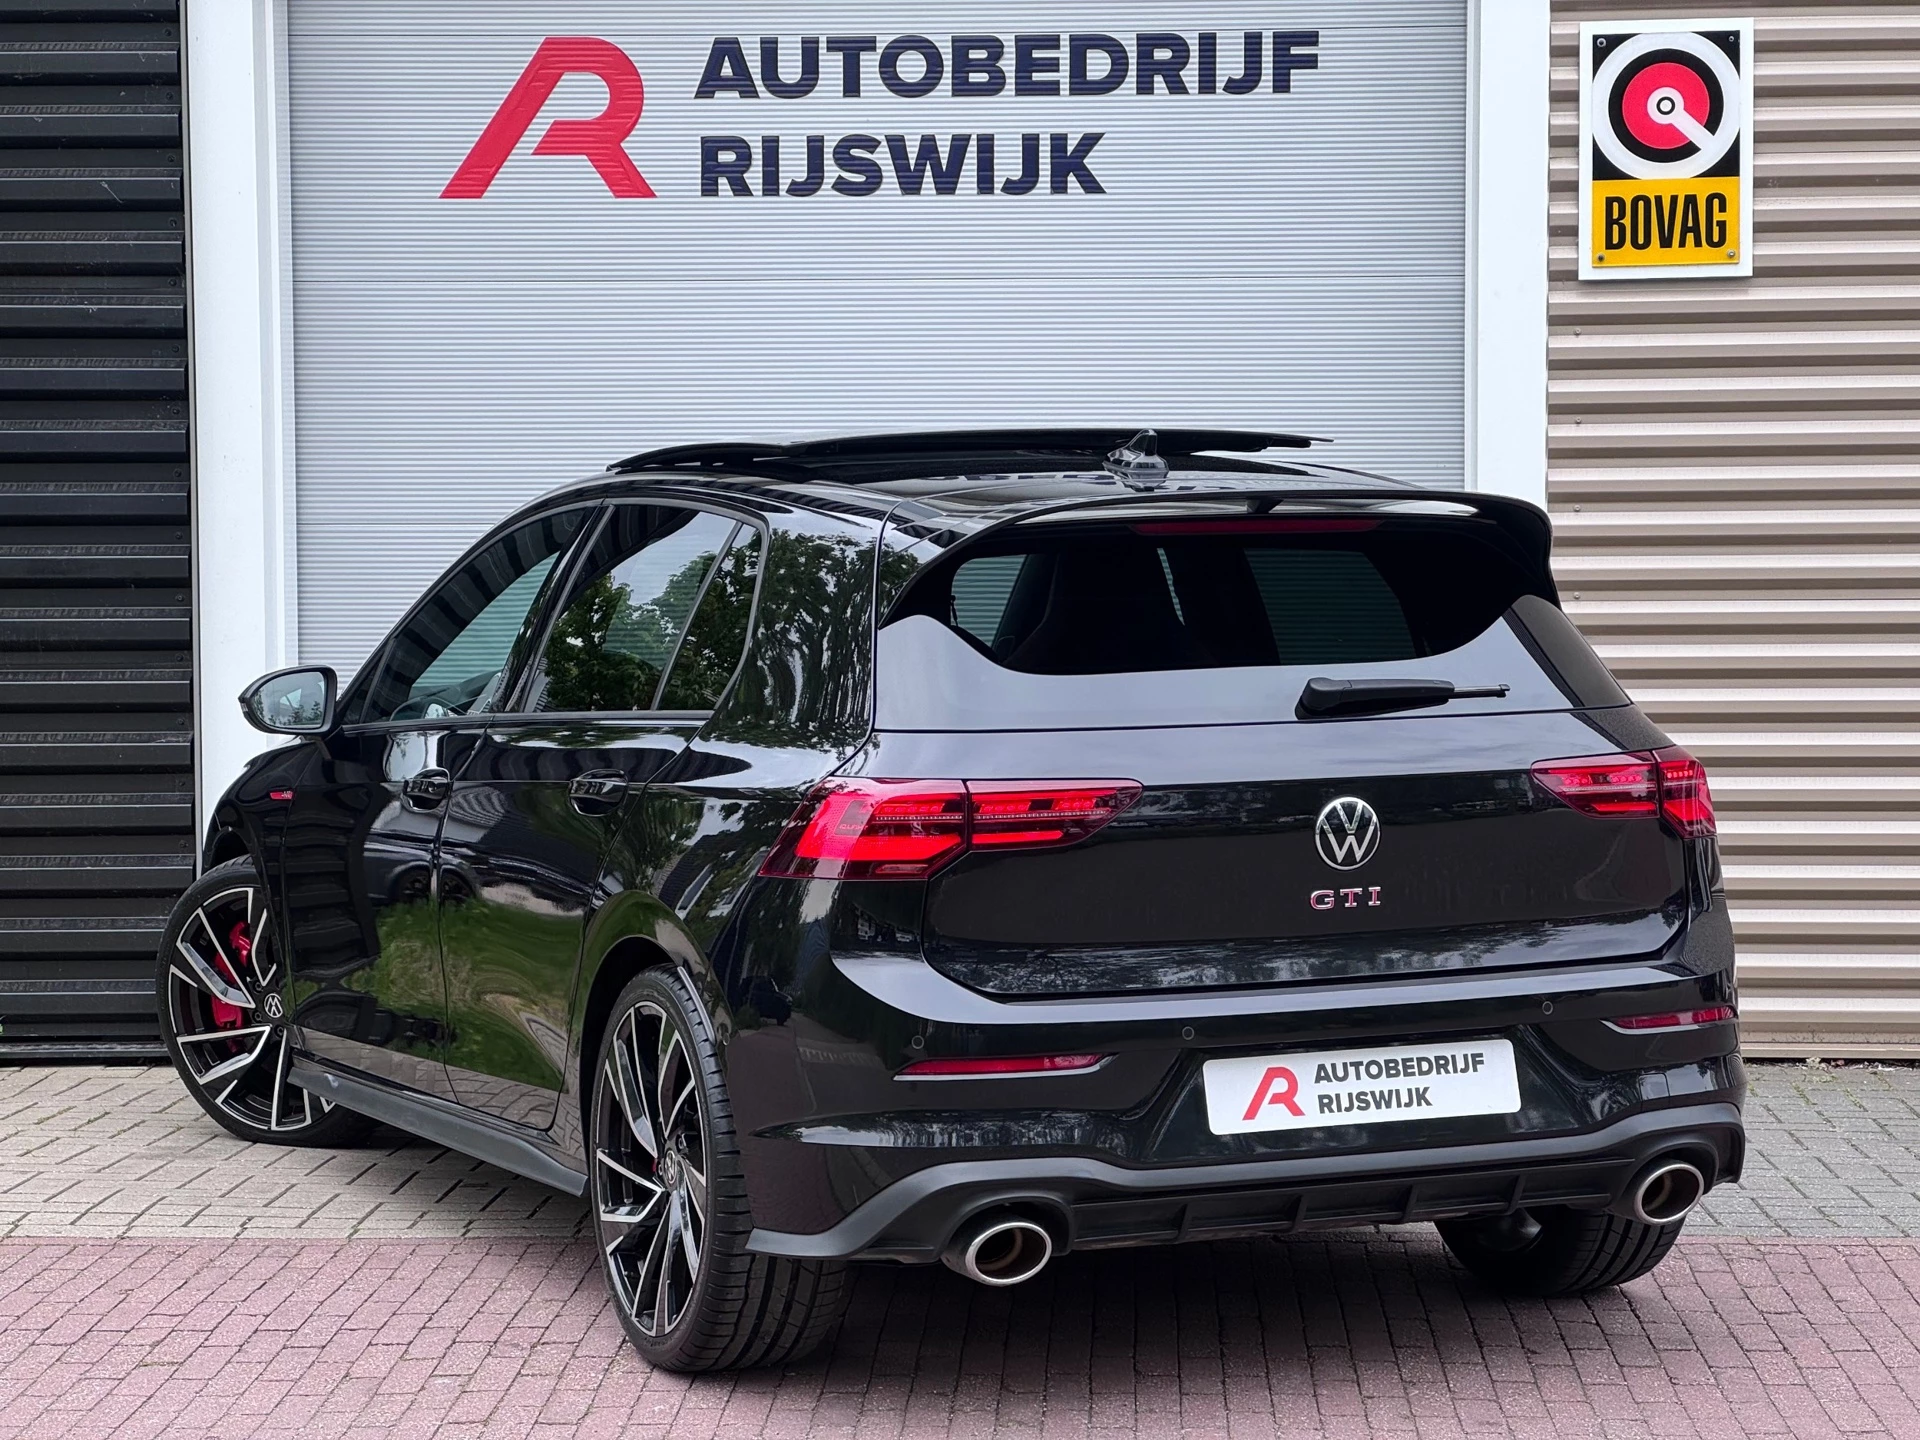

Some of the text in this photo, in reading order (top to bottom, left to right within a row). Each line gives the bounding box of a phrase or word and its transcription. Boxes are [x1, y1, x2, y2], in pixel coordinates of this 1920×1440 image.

[694, 31, 1320, 99] AUTOBEDRIJF
[700, 133, 1107, 197] RIJSWIJK
[1604, 192, 1727, 250] BOVAG
[1310, 886, 1381, 910] GTI
[1313, 1052, 1485, 1084] AUTOBEDRIJF
[1317, 1086, 1433, 1114] RIJSWIJK
